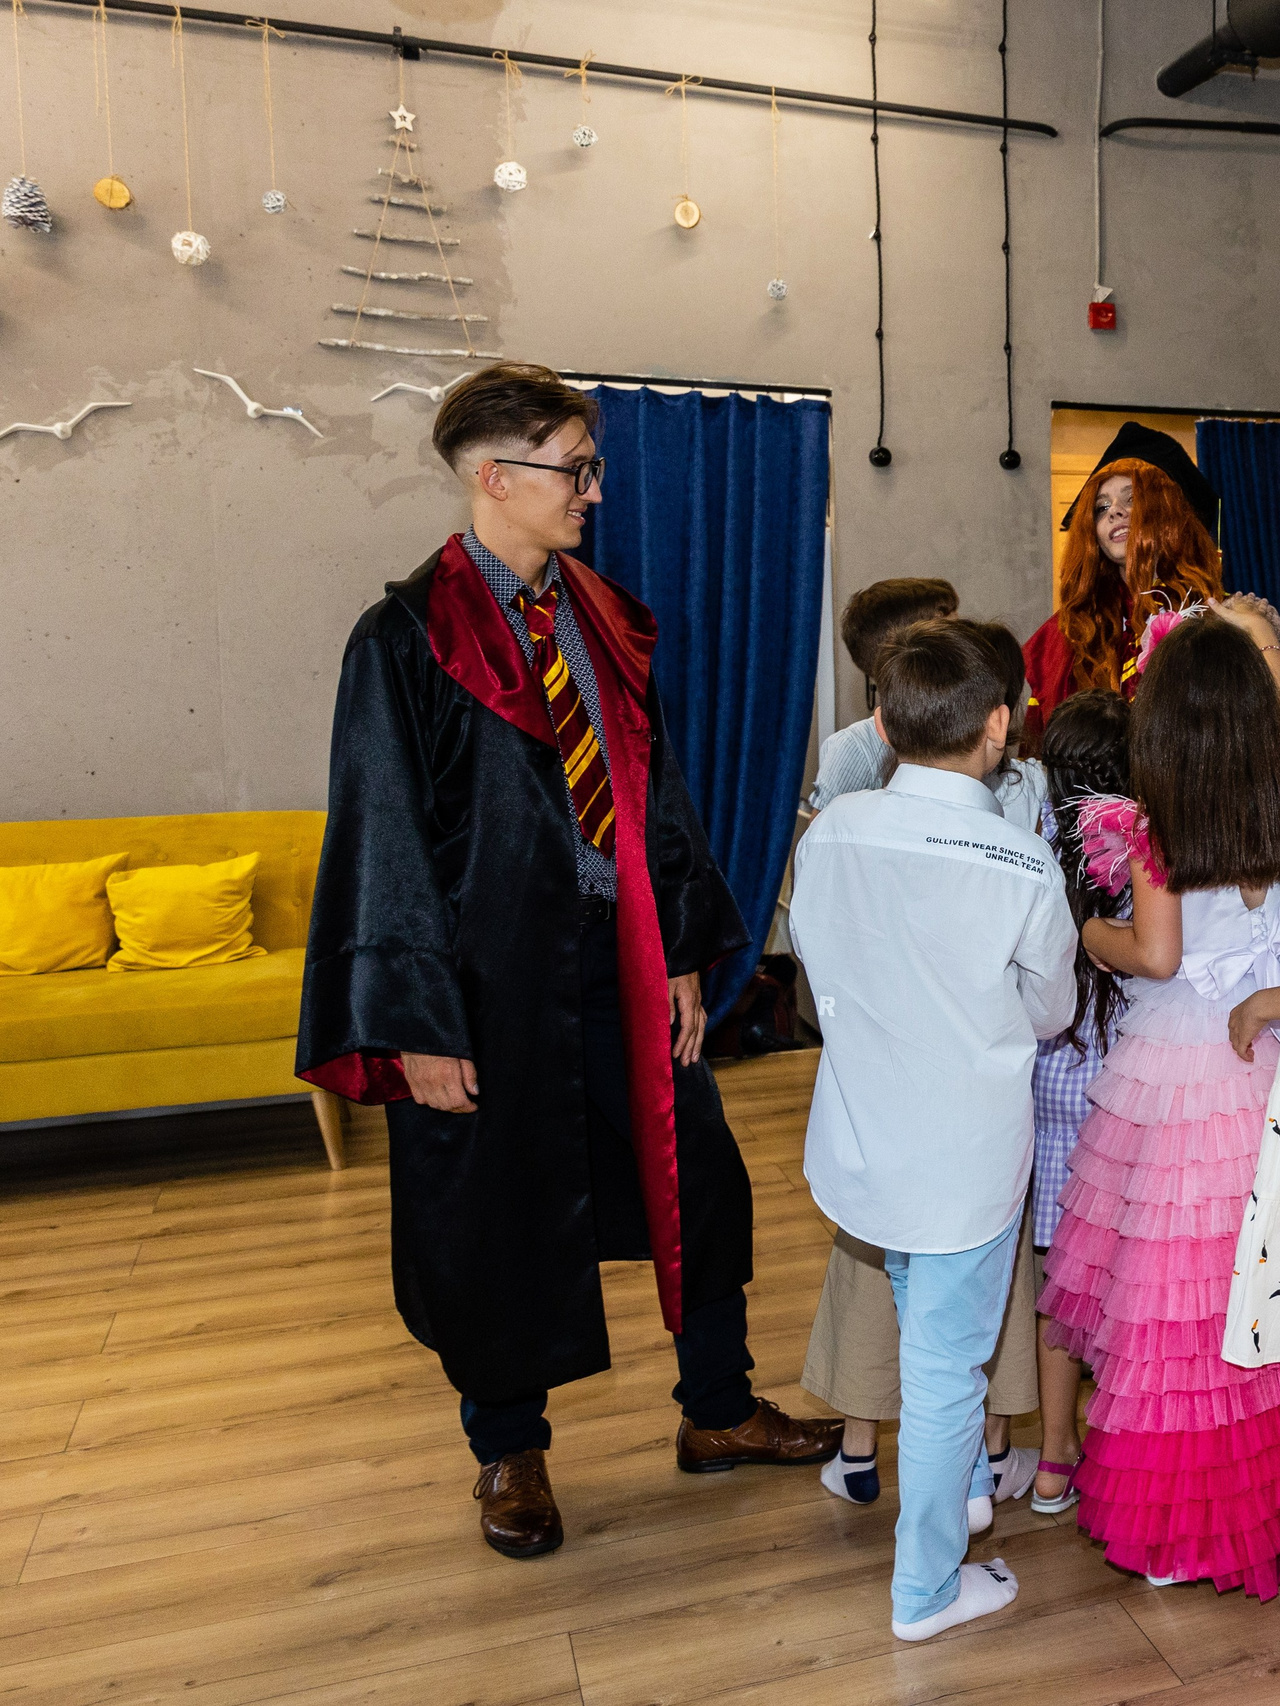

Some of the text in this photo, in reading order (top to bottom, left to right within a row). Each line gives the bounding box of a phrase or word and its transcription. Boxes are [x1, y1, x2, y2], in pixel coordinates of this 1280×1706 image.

[926, 836, 1045, 867] GULLIVER WEAR SINCE 1997
[985, 852, 1044, 875] UNREAL TEAM
